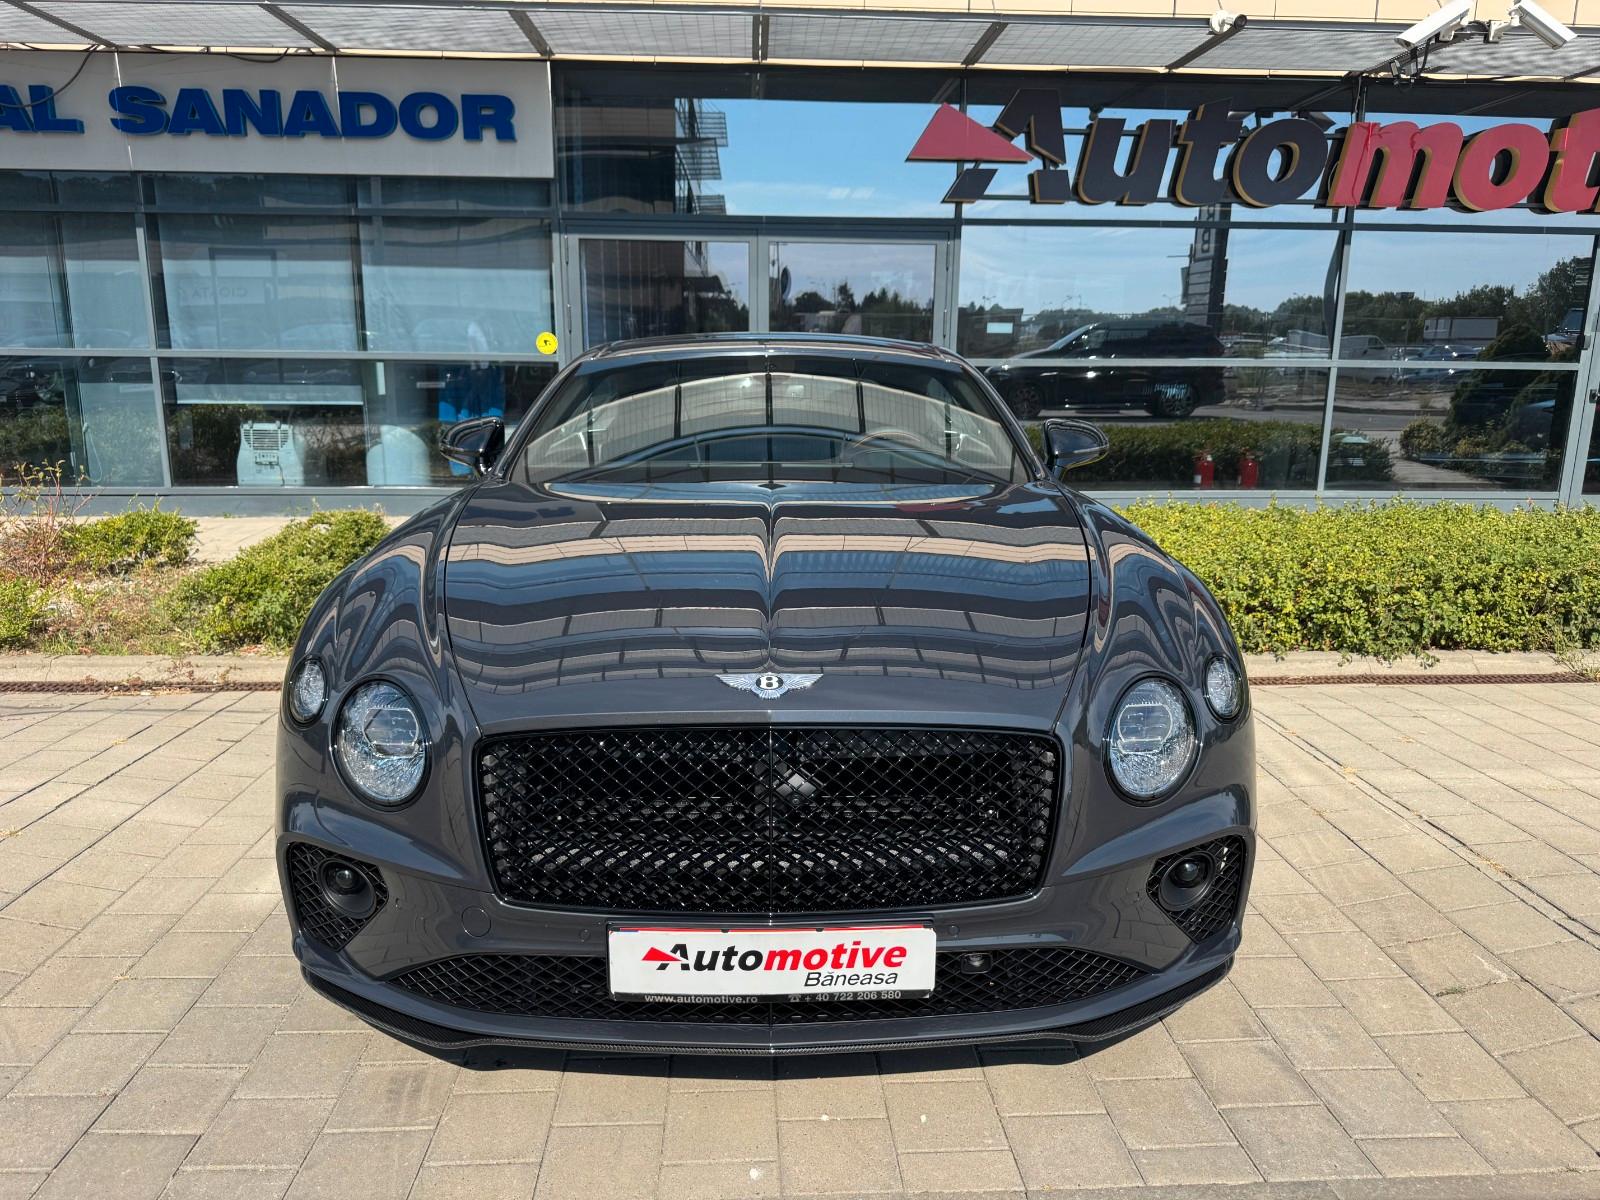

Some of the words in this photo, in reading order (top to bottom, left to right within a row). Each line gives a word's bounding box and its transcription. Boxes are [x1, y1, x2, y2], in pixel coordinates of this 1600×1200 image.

[108, 85, 518, 142] SANADOR
[906, 88, 1600, 213] Automot
[642, 940, 907, 972] Automotive
[804, 971, 898, 987] Băneasa
[644, 994, 759, 1004] www.automotive.ro
[815, 992, 830, 1001] 40
[833, 992, 854, 1001] 722
[857, 991, 878, 1000] 206
[881, 989, 902, 999] 580
